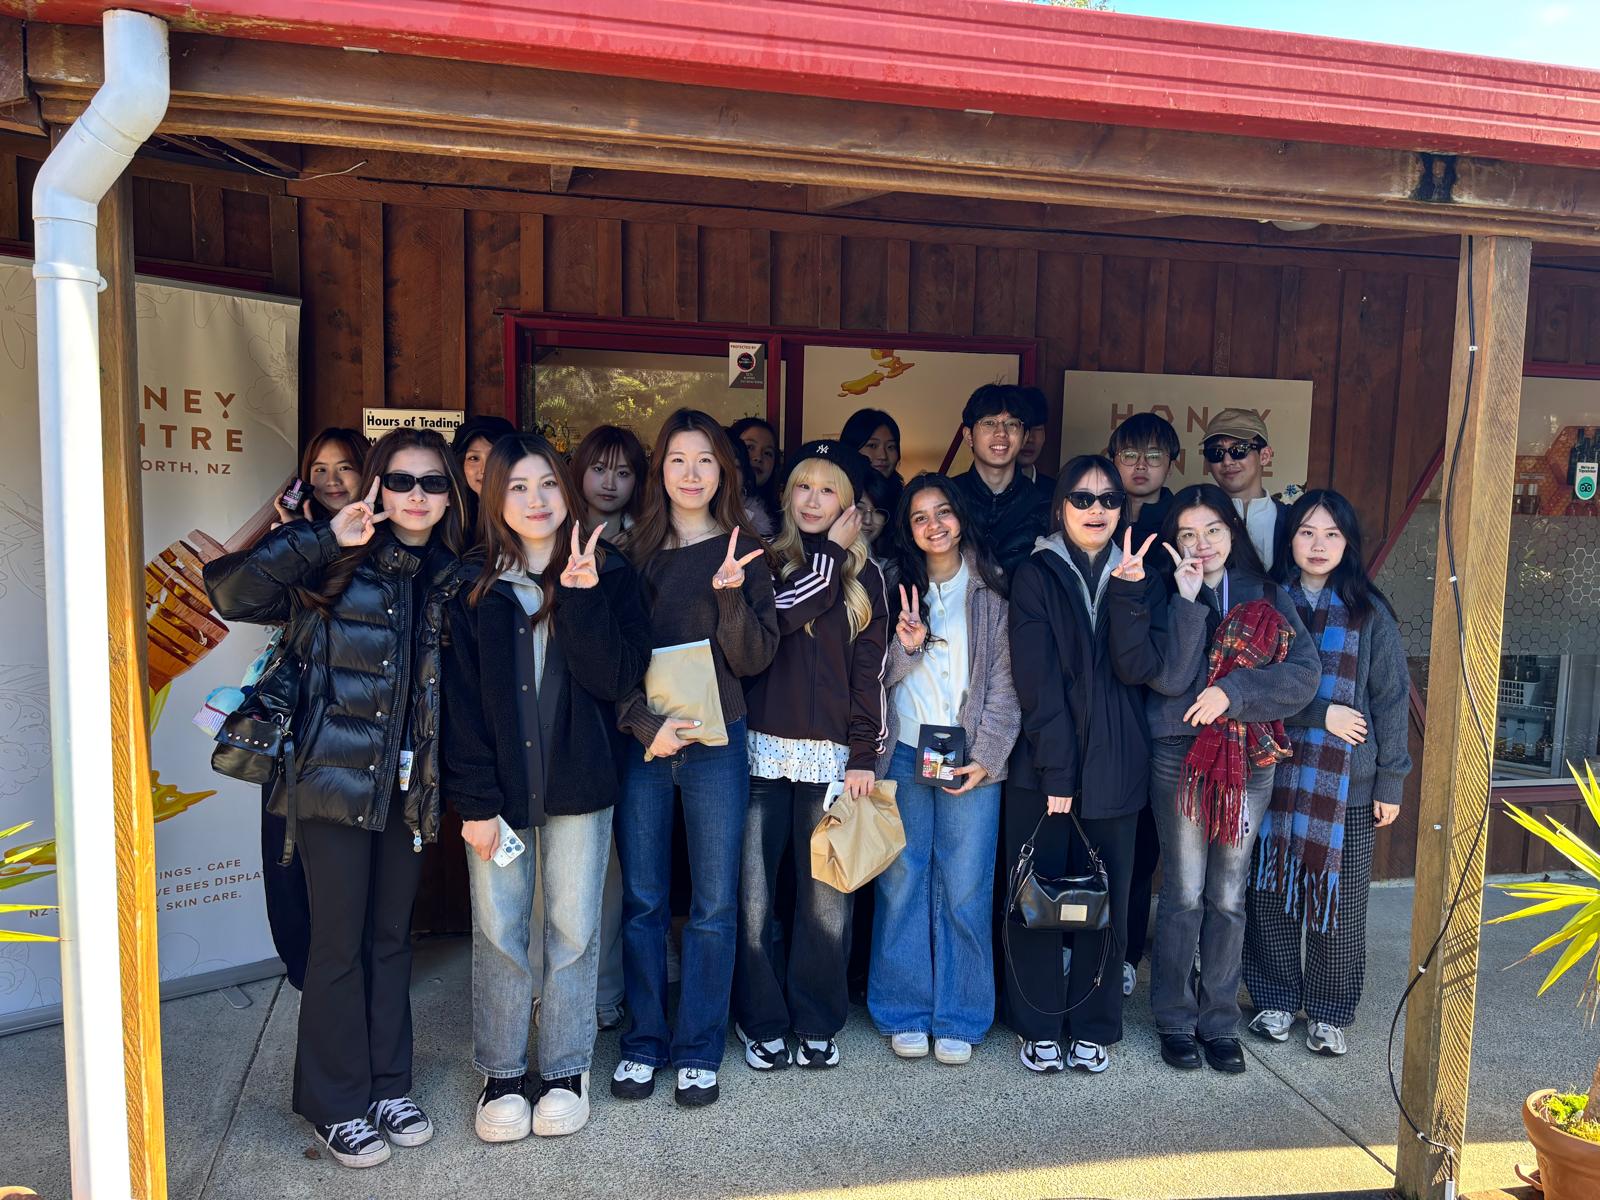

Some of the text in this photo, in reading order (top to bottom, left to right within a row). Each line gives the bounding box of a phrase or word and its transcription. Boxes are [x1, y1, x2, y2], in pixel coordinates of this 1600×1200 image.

[367, 415, 460, 429] Hours of Trading
[207, 463, 231, 475] NZ
[156, 859, 241, 880] INGS CAFE
[176, 880, 209, 893] BEES
[166, 898, 198, 911] SKIN
[203, 890, 242, 904] CARE.
